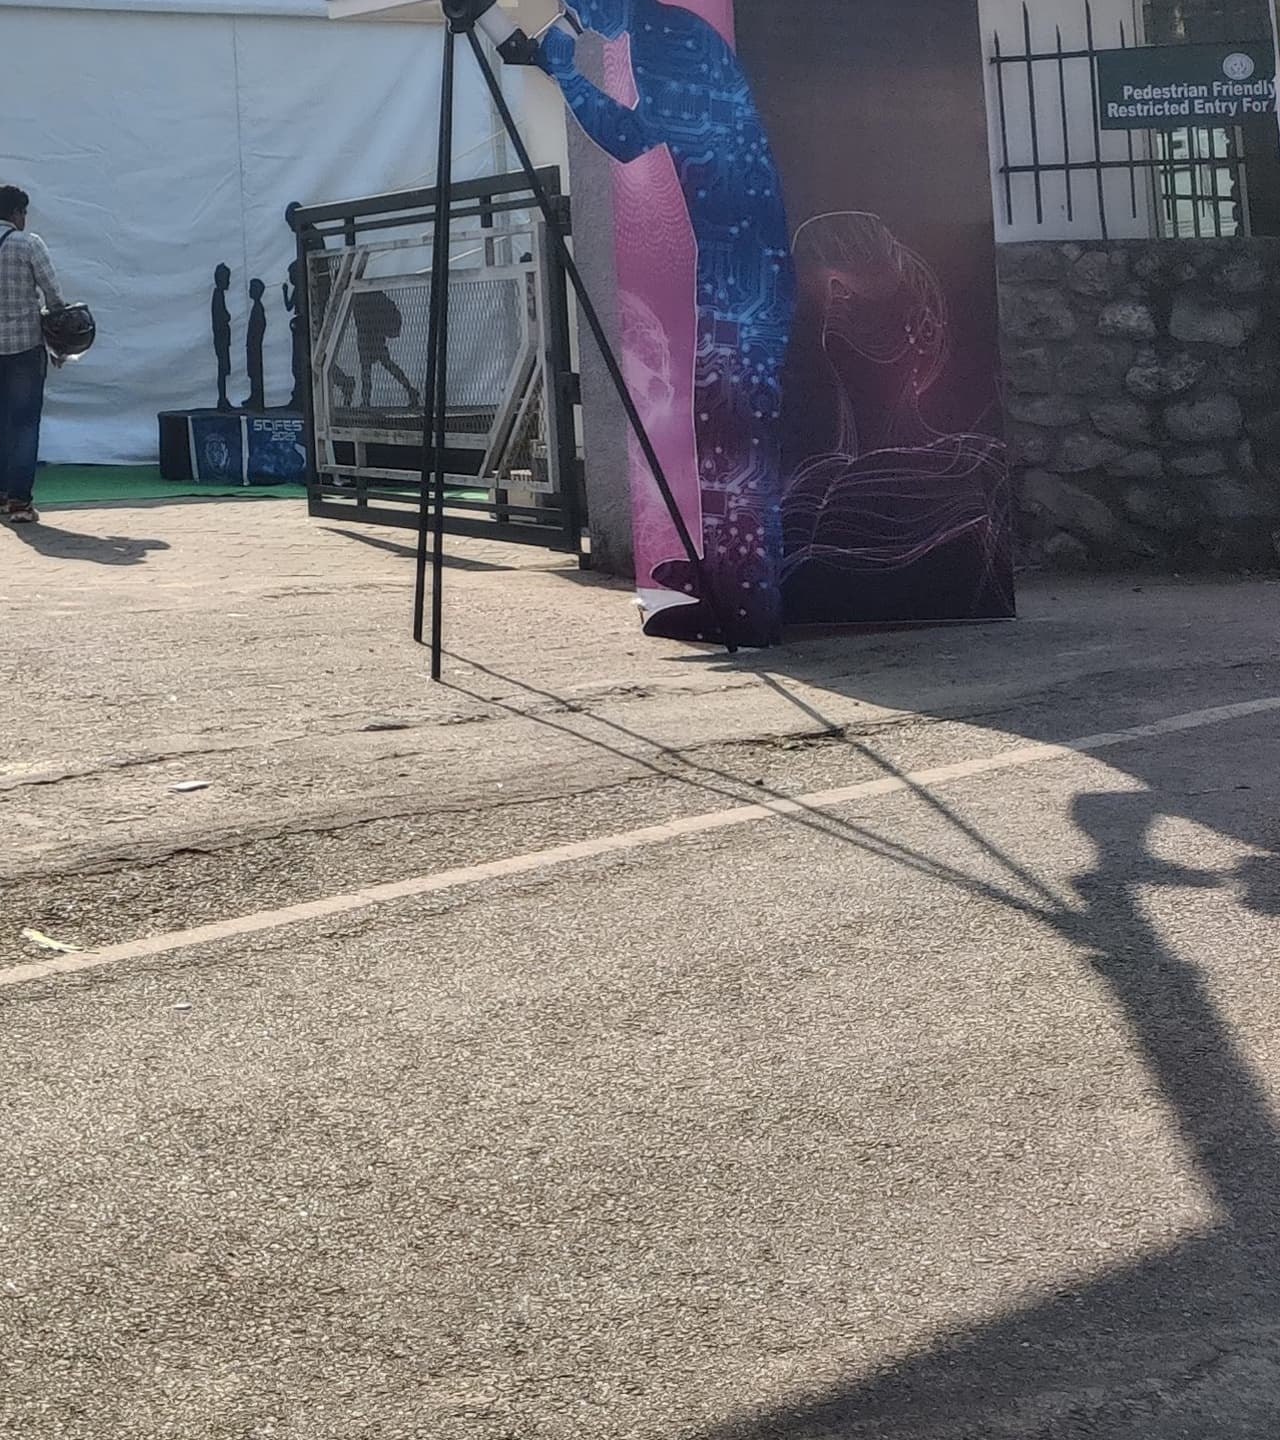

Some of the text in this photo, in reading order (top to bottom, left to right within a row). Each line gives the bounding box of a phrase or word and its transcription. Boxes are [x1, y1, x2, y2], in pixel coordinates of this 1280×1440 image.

[1123, 78, 1276, 101] Pedestrian Friendly
[1107, 98, 1269, 118] Restricted Entry For
[253, 419, 304, 432] SCIFES
